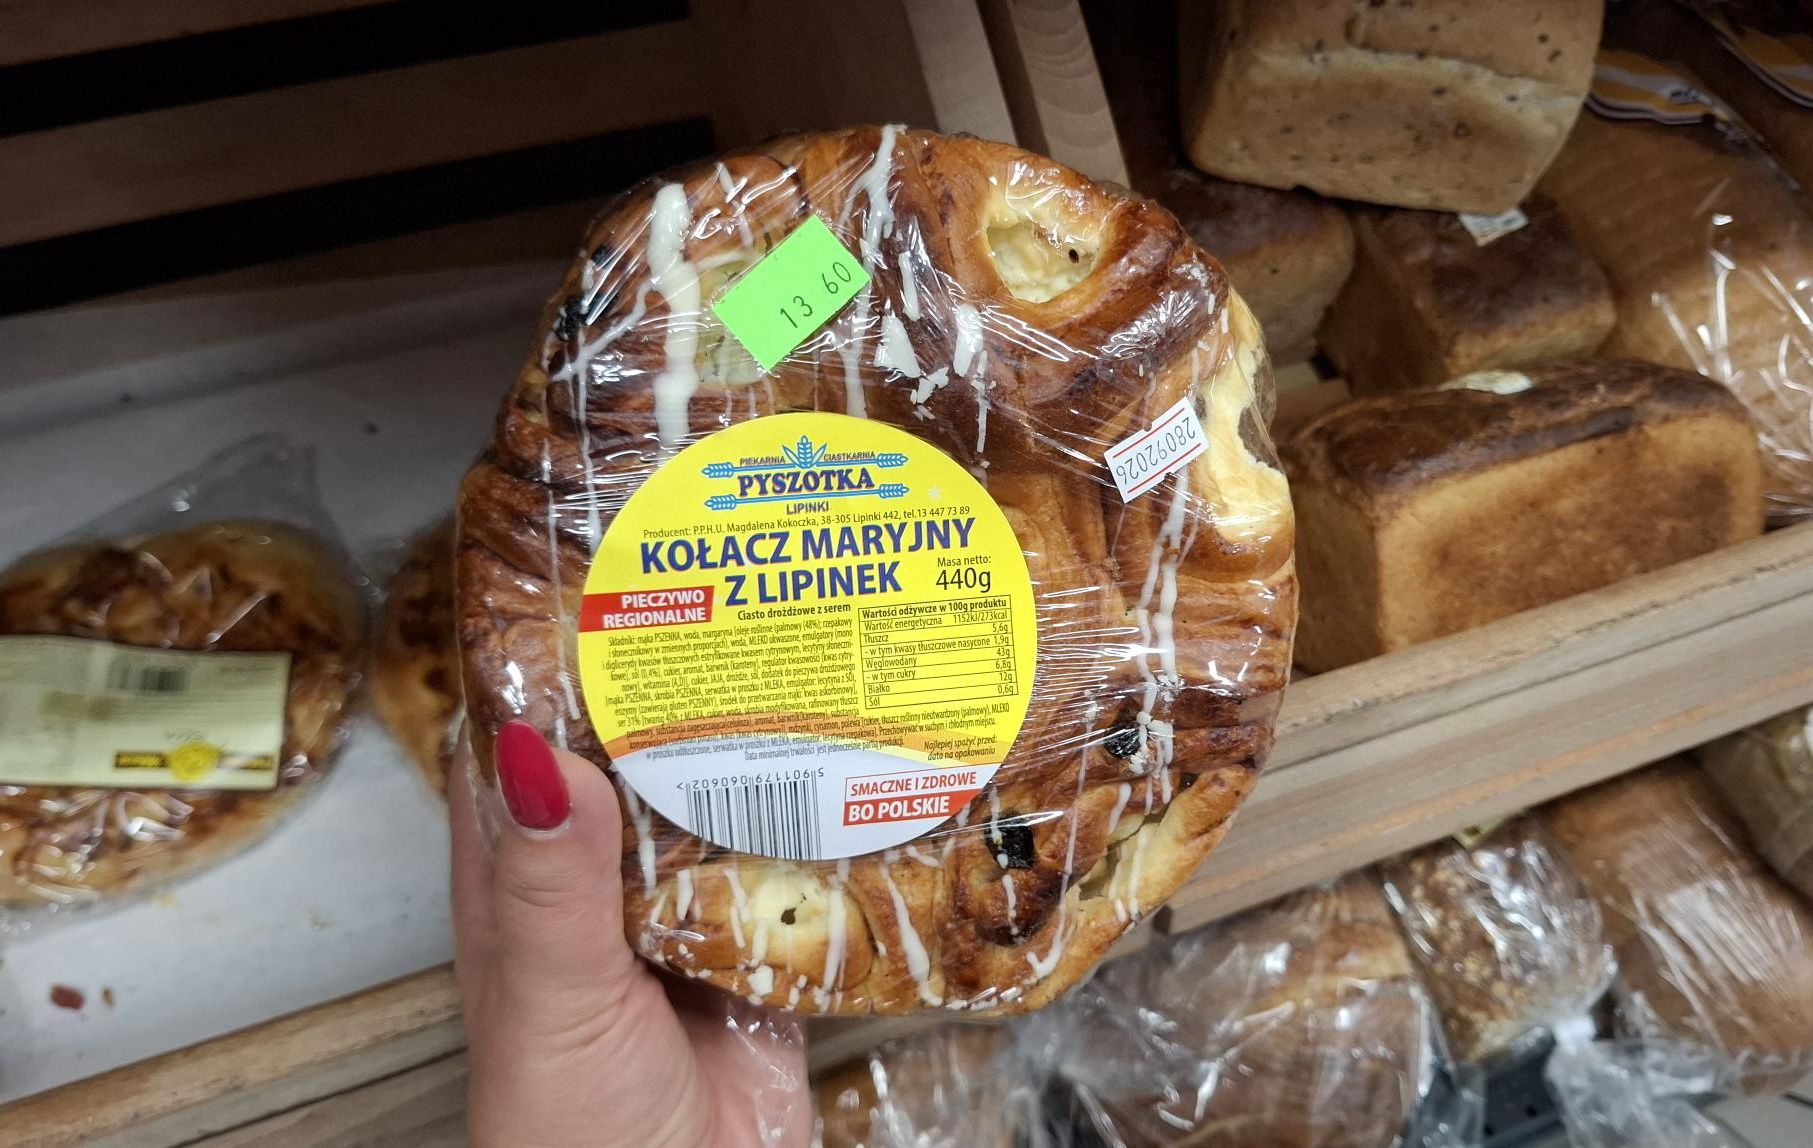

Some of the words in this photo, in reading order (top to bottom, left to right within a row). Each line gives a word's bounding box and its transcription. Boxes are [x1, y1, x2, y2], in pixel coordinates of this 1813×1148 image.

[780, 296, 813, 328] 13
[821, 261, 851, 294] 60
[740, 455, 786, 466] PIEKARNIA
[824, 451, 875, 462] CIASTKARNIA
[1116, 417, 1196, 485] 28092026
[738, 467, 875, 497] PYSZOTKA
[786, 501, 829, 515] LIPINKI
[643, 527, 691, 538] Producent:
[693, 524, 724, 535] P.P.H.U.
[727, 521, 775, 534] Magdalena
[777, 517, 818, 528] Kokoczka,
[821, 514, 850, 525] 38-305
[853, 511, 881, 524] Lipinki
[883, 510, 901, 520] 442,
[929, 508, 944, 516] 447
[947, 506, 957, 516] 73
[960, 506, 970, 514] 89
[641, 531, 792, 574] KOŁACZ
[802, 517, 975, 561] MARYJNY
[938, 557, 961, 568] Masa
[964, 555, 991, 566] netto:
[725, 575, 748, 607] Z
[758, 561, 902, 604] LIPINEK
[936, 568, 991, 593] 440g
[622, 589, 705, 608] PIECZYWO
[863, 607, 897, 619] Wartości
[899, 605, 937, 618] odżywcze
[948, 602, 968, 612] 100g
[970, 599, 1006, 612] produktu
[603, 607, 706, 628] REGIONALNE
[738, 610, 765, 621] Ciasto
[766, 606, 816, 619] drożdżowe
[824, 606, 850, 614] serem
[865, 620, 894, 631] Wartość
[895, 618, 942, 630] energetyczna
[953, 611, 1007, 624] 1152kJ/273kcal
[864, 634, 888, 644] Tłuszcz
[992, 624, 1008, 634] 5,6g
[878, 645, 892, 656] tym
[894, 642, 916, 655] kwasy
[958, 638, 990, 648] nasycone
[994, 636, 1009, 646] 1,9g
[866, 657, 917, 670] Węglowodany
[996, 648, 1010, 658] 43g
[880, 671, 895, 683] tym
[896, 669, 916, 682] cukry
[996, 660, 1012, 670] 6,8g
[868, 684, 890, 694] Białko
[1000, 672, 1012, 682] 12g
[869, 696, 880, 706] Sól
[998, 684, 1014, 695] 0,6g
[924, 740, 953, 750] Najlepiej
[978, 736, 997, 747] przed:
[928, 752, 944, 761] data
[955, 748, 995, 759] opakowaniu
[851, 778, 912, 796] SMACZNE
[915, 778, 919, 790] I
[922, 772, 976, 789] ZDROWE
[848, 804, 874, 822] BO
[878, 796, 950, 819] POLSKIE
